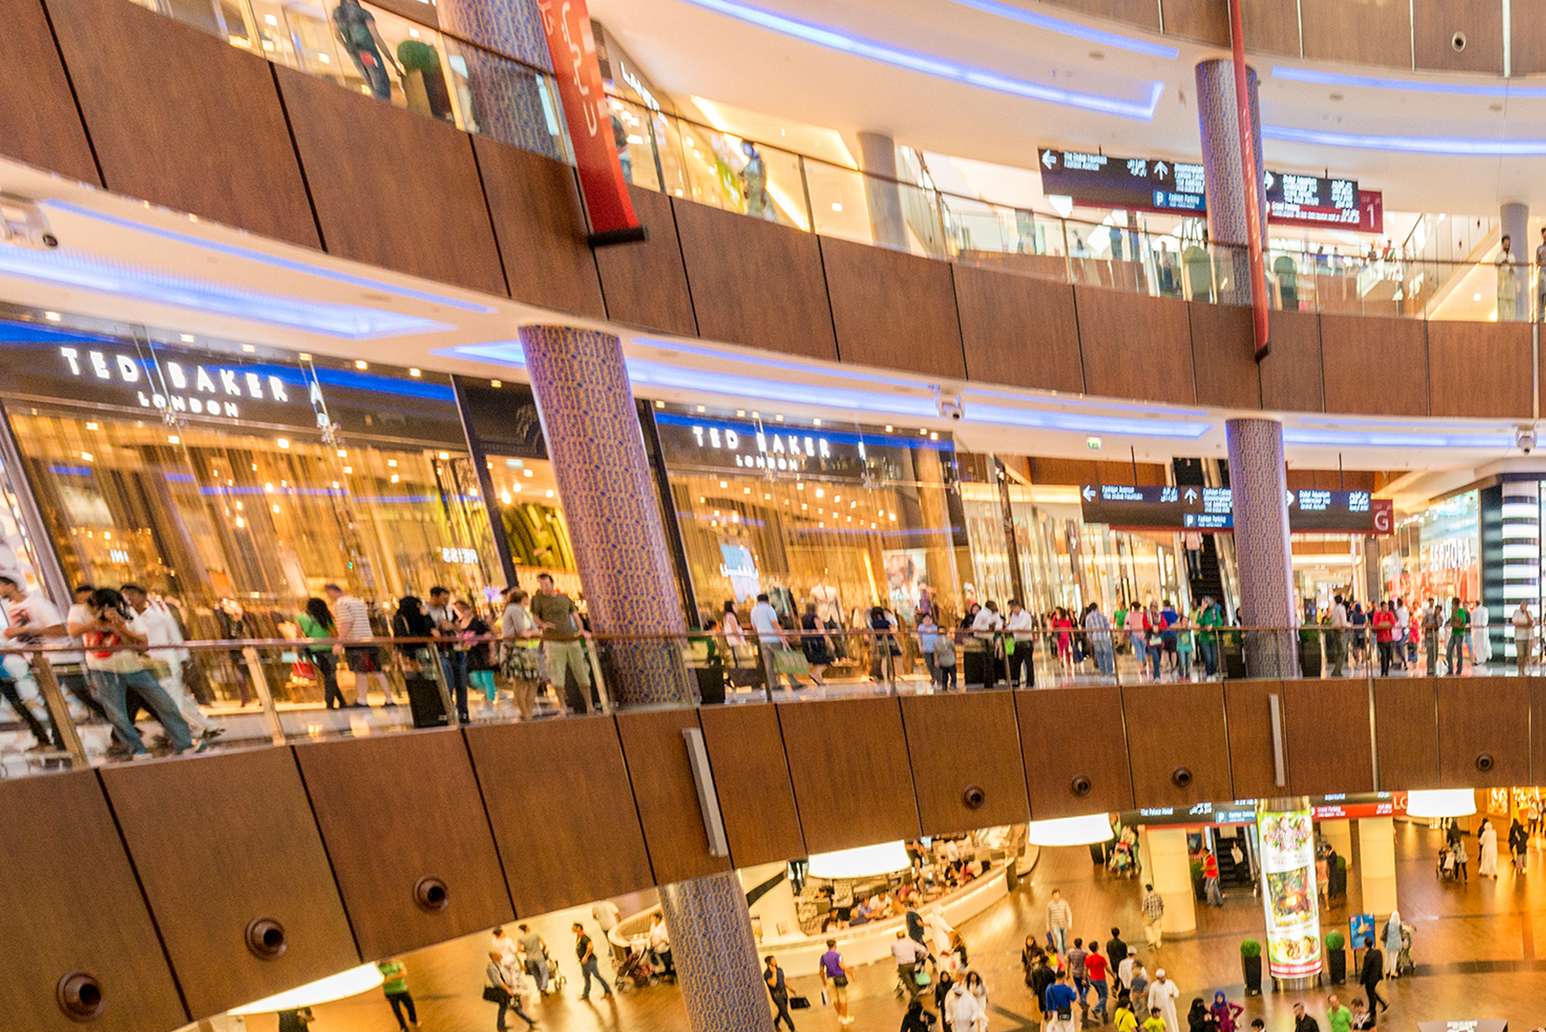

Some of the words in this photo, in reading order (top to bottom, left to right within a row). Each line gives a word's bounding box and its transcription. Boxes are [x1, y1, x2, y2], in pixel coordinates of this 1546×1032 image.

[1366, 204, 1376, 229] 1
[61, 346, 140, 383] TED
[168, 361, 289, 403] BAKER
[138, 390, 239, 418] LONDON
[692, 425, 739, 450] TED
[1374, 511, 1389, 531] G
